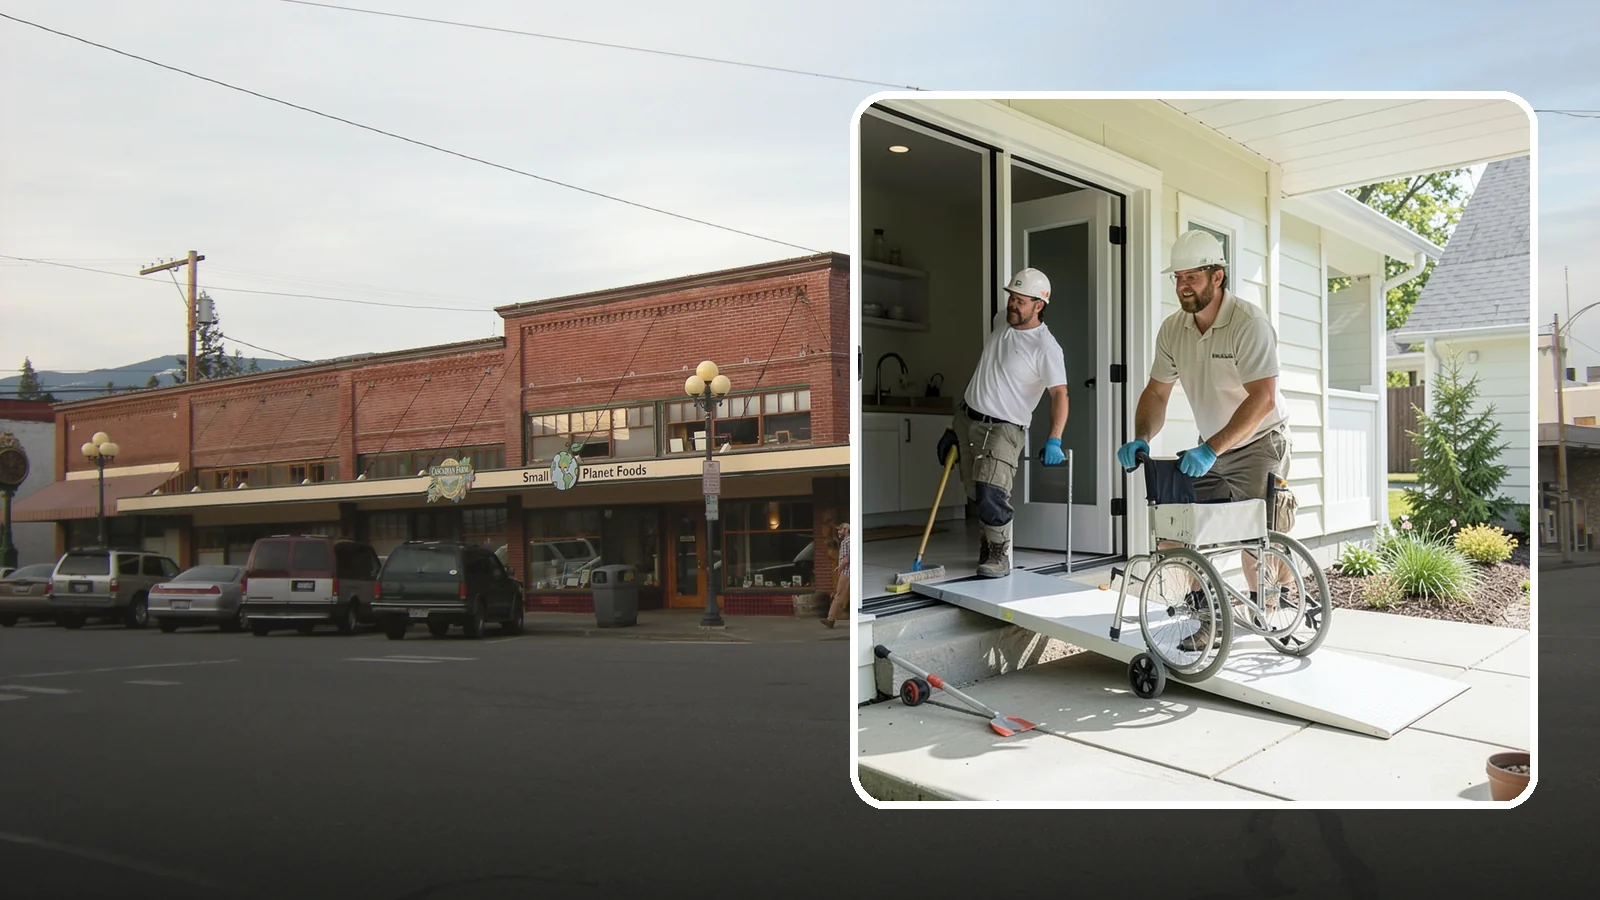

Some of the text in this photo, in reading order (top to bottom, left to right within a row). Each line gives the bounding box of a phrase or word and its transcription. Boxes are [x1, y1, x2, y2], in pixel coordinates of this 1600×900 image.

[523, 464, 647, 482] Small Planet Foods
